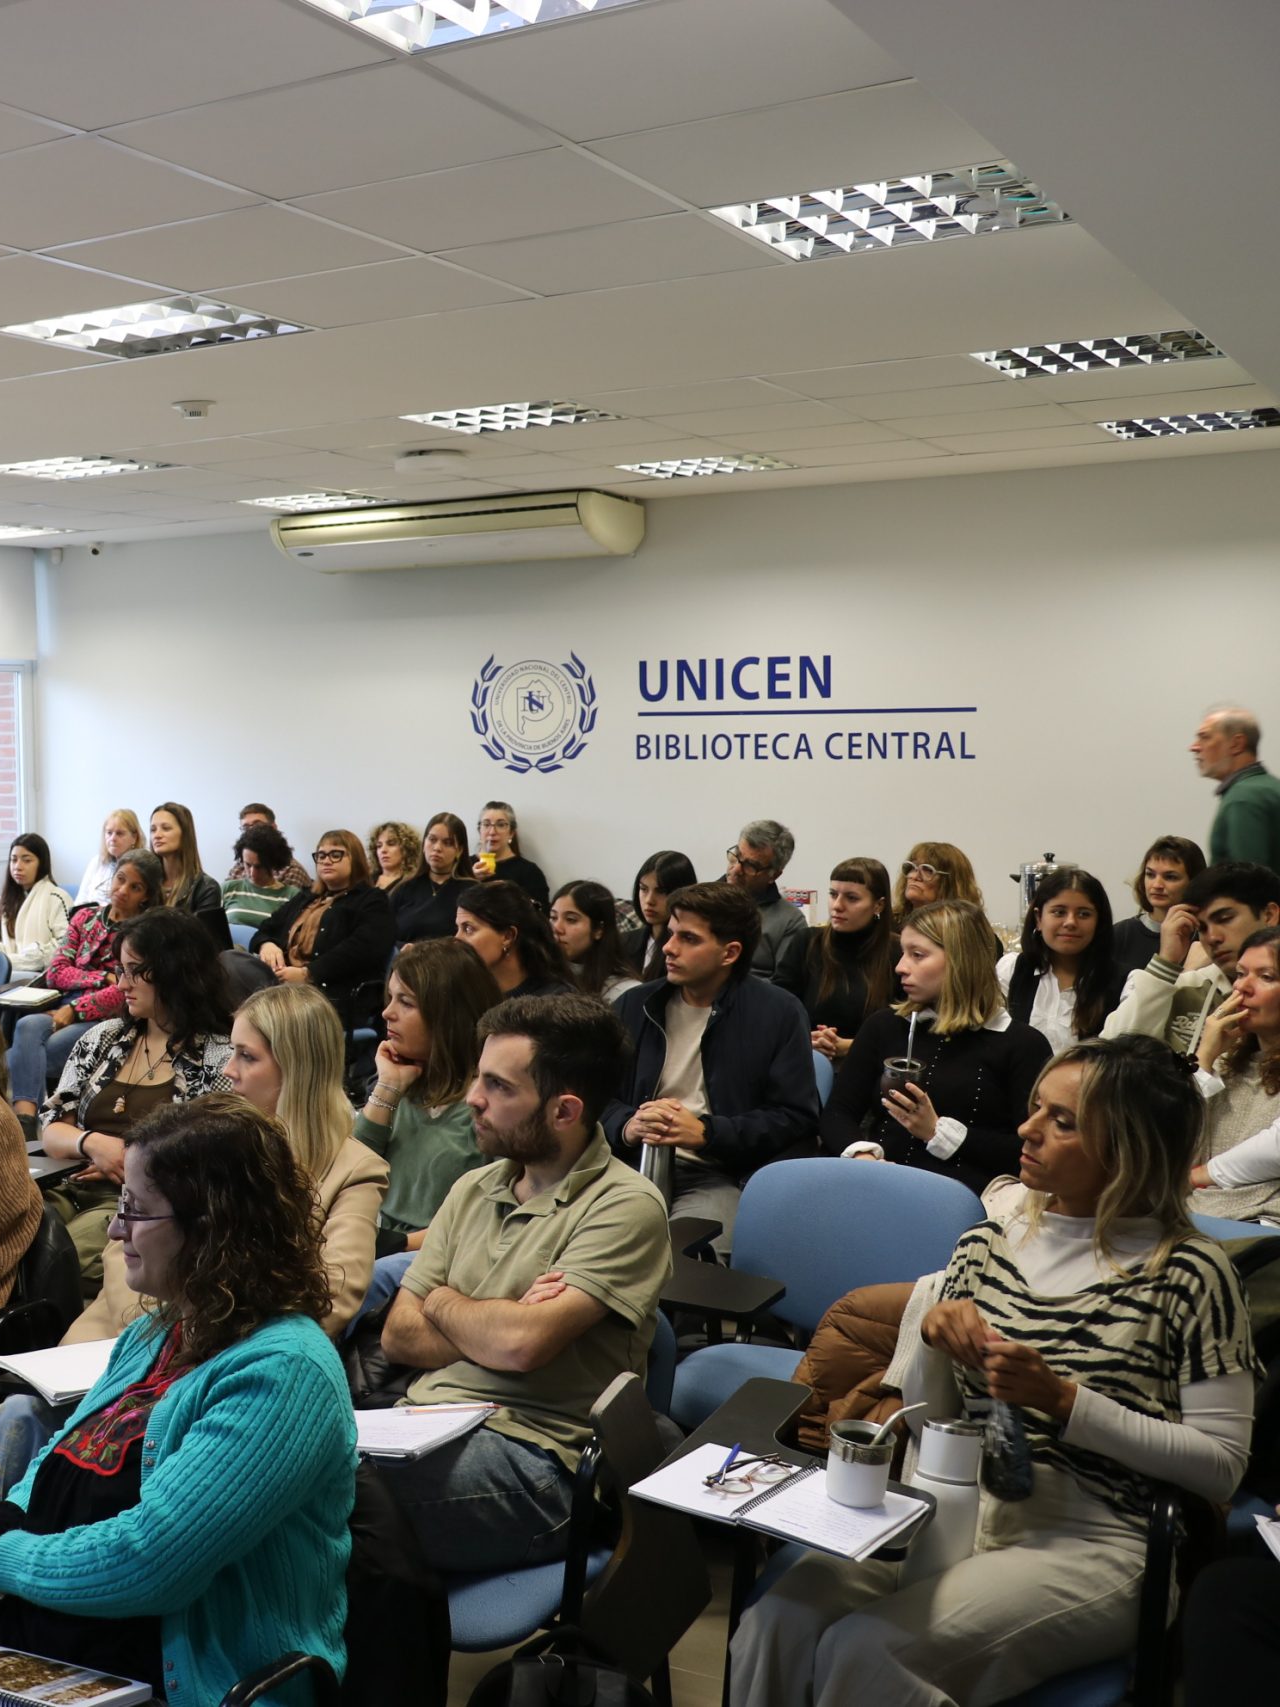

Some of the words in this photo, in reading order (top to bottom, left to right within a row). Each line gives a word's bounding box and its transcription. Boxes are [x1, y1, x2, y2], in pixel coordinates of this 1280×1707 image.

[495, 669, 519, 705] UNIVERSIDAD
[520, 665, 549, 673] NACIONAL
[550, 670, 560, 681] DEL
[559, 679, 572, 704] CENTRO
[639, 655, 832, 702] UNICEN
[500, 727, 507, 736] LA
[506, 734, 532, 750] PROVINCIA
[542, 734, 561, 750] BUENOS
[560, 718, 571, 735] AIRES
[636, 733, 813, 760] BIBLIOTECA
[825, 731, 976, 760] CENTRAL
